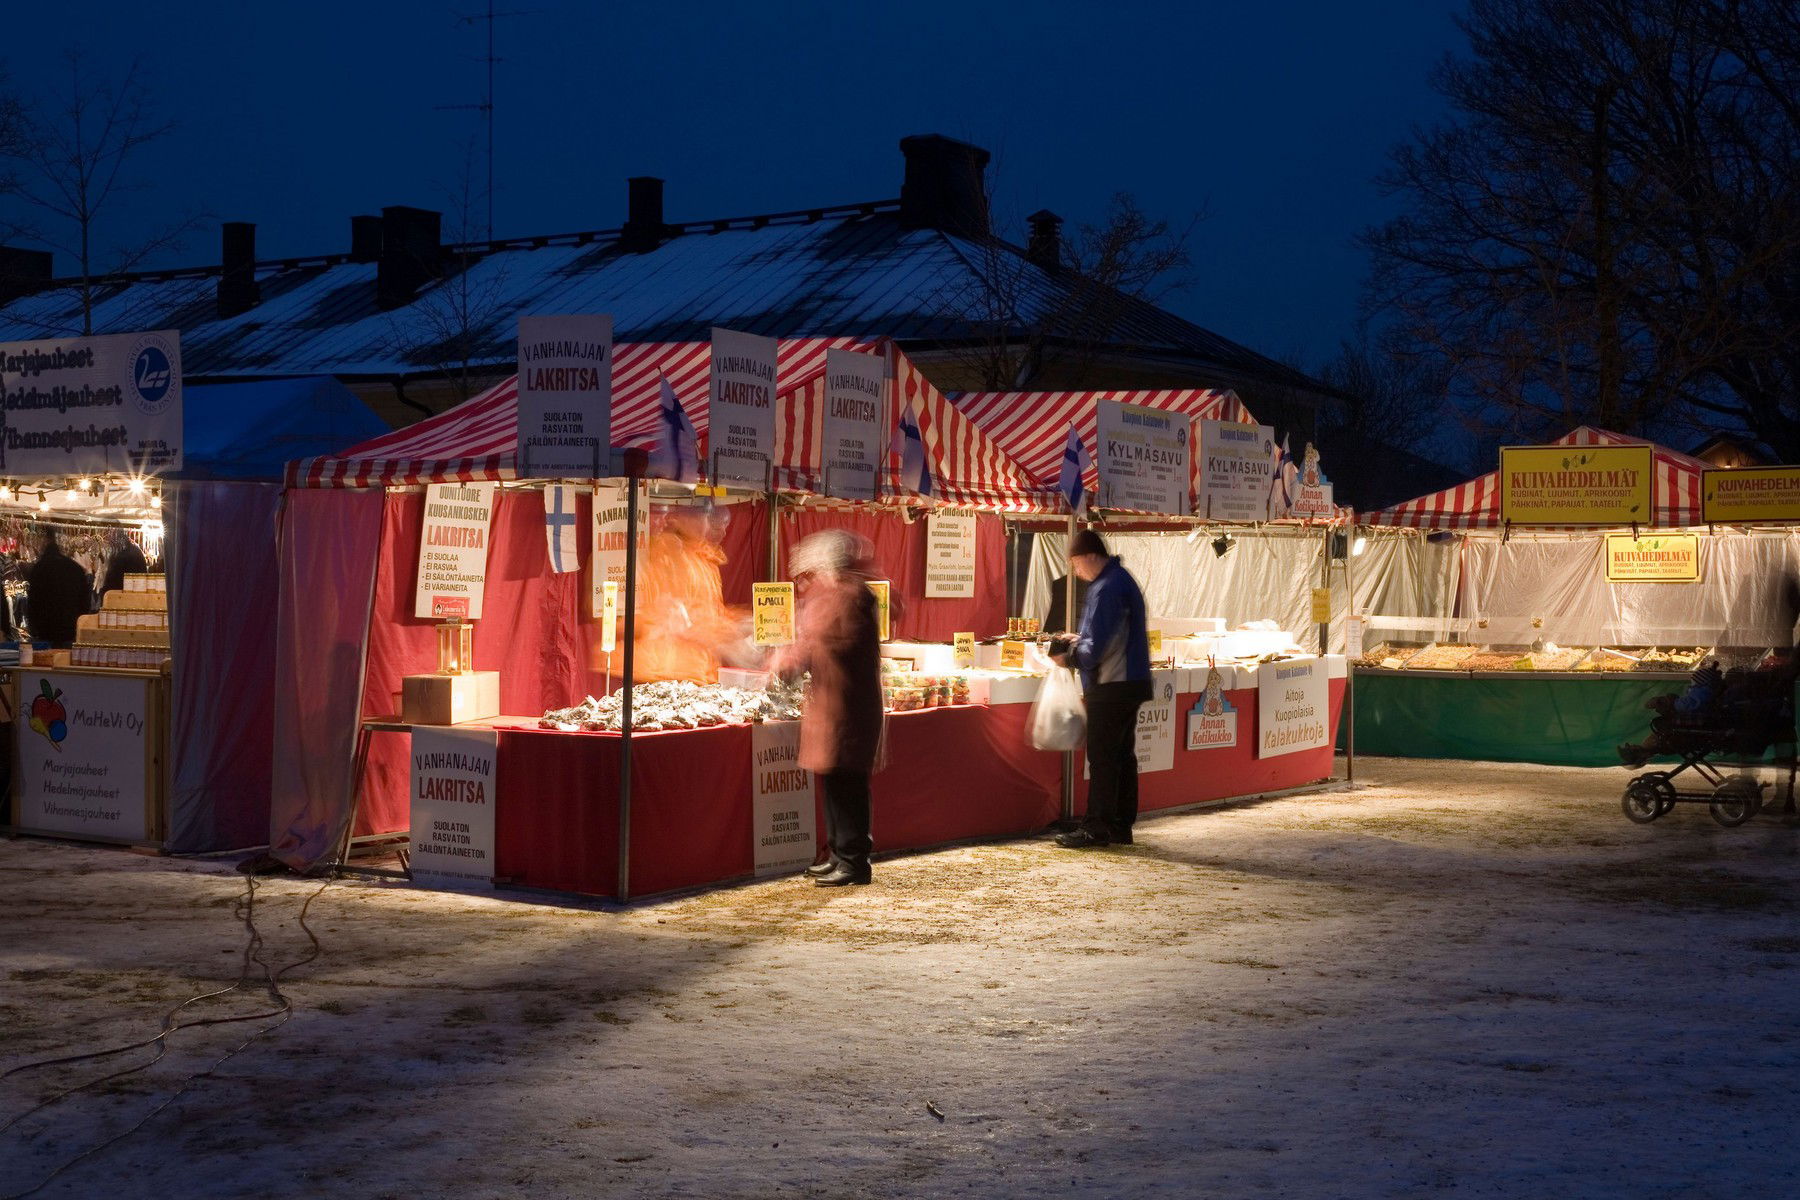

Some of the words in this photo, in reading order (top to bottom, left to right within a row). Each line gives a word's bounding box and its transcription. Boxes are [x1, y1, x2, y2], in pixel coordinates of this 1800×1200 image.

[523, 341, 605, 362] VANHANAJAN
[716, 357, 773, 382] VANHANAJAN
[528, 368, 599, 391] LAKRITSA
[830, 375, 879, 397] VANHANAJAN
[718, 379, 769, 408] LAKRITSA
[544, 412, 582, 422] SUOLATON
[831, 397, 875, 422] LAKRITSA
[542, 424, 583, 434] RASVATON
[729, 425, 756, 436] SUOLATON
[728, 436, 756, 448] RASVATON
[1108, 440, 1182, 466] KYLMÄSAVU
[1209, 457, 1269, 475] KYLMÄSAVU
[1511, 469, 1639, 488] KUIVAHEDELMÄT
[1300, 487, 1322, 499] Annan
[1511, 490, 1545, 498] RUSINAT,
[1548, 490, 1581, 498] LUUMUT,
[1584, 489, 1633, 498] APRIKOOSIT,
[428, 504, 488, 521] KUUSANKOSKEN
[1295, 500, 1329, 512] Kotikukko
[1512, 500, 1550, 508] PÄHKINÄT,
[596, 506, 647, 526] VANHANAN
[427, 525, 483, 548] LAKRITSA
[598, 531, 646, 552] LAKRISA
[434, 553, 458, 561] SUOLAA
[1614, 550, 1691, 561] KUIVAHEDELMÄT
[434, 563, 457, 571] RASVAA
[758, 597, 784, 606] LAKU
[1285, 688, 1304, 703] Aitoja
[1275, 704, 1314, 722] Kuopiolaisia
[73, 710, 122, 728] MaHeVi
[127, 712, 144, 736] Oy
[1200, 717, 1225, 730] Annan
[1192, 730, 1232, 745] Kotikukko
[1264, 721, 1324, 748] Kalakukkoja
[416, 752, 490, 776] VANHANAJAN
[757, 746, 800, 766] VANHANA
[44, 760, 108, 778] Marjajauheet
[44, 780, 120, 800] Hedelmäjauheet
[419, 777, 485, 804] LAKRITSA
[760, 769, 808, 794] LAKRITSA
[44, 802, 121, 823] Vihannesjauheet
[772, 811, 799, 822] SUOLATON
[434, 821, 469, 832] SUOLATON
[772, 822, 800, 833] RASVATON
[433, 833, 470, 845] RASVATON
